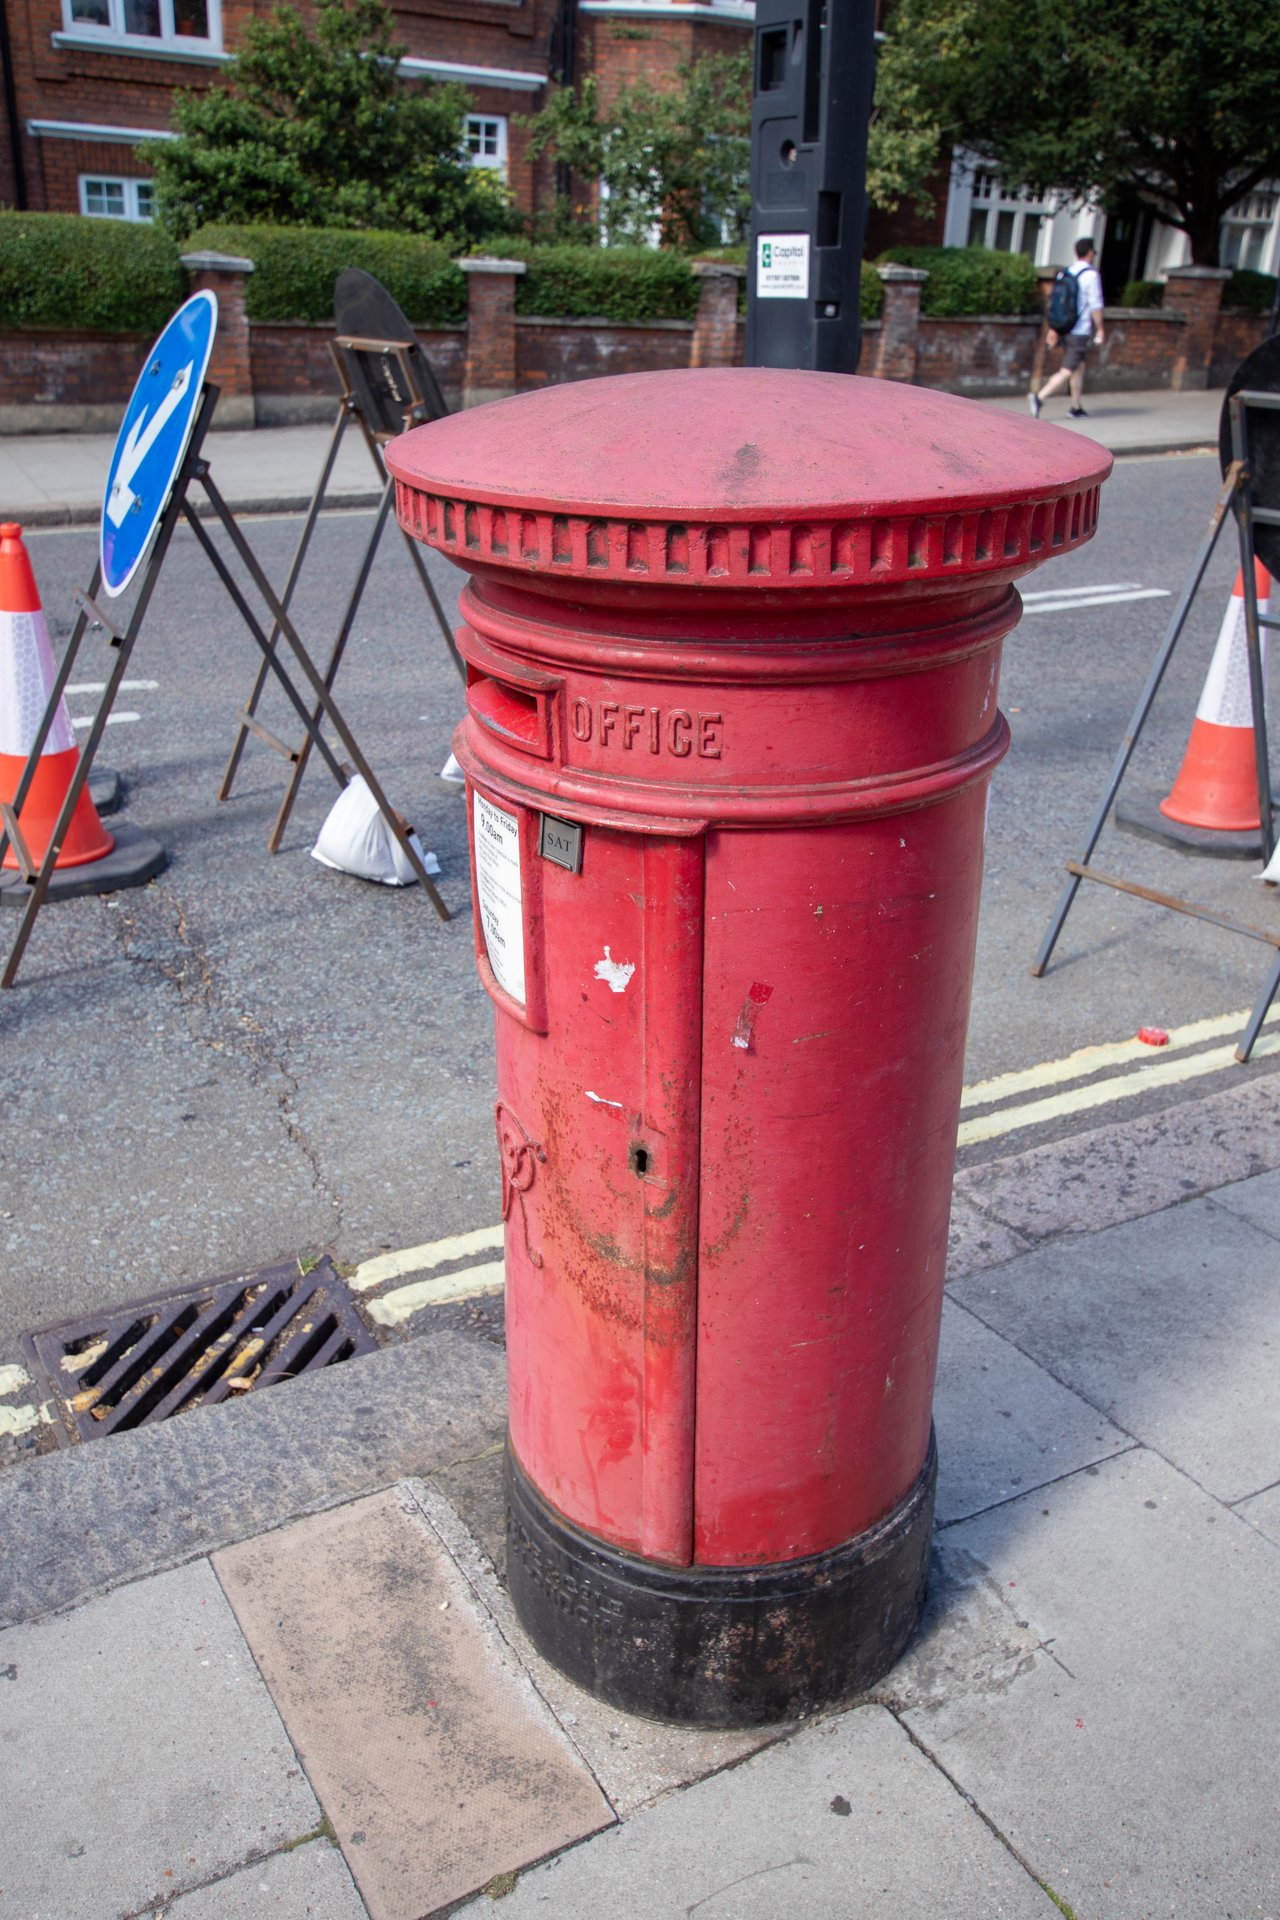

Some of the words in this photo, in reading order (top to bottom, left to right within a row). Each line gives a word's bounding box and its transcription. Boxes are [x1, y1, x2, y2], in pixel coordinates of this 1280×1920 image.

[773, 246, 804, 260] Capital
[572, 696, 722, 760] OFFICE
[478, 795, 493, 819] Monday
[500, 815, 518, 838] Friday
[481, 813, 504, 845] 9.00am
[547, 832, 573, 852] SAT
